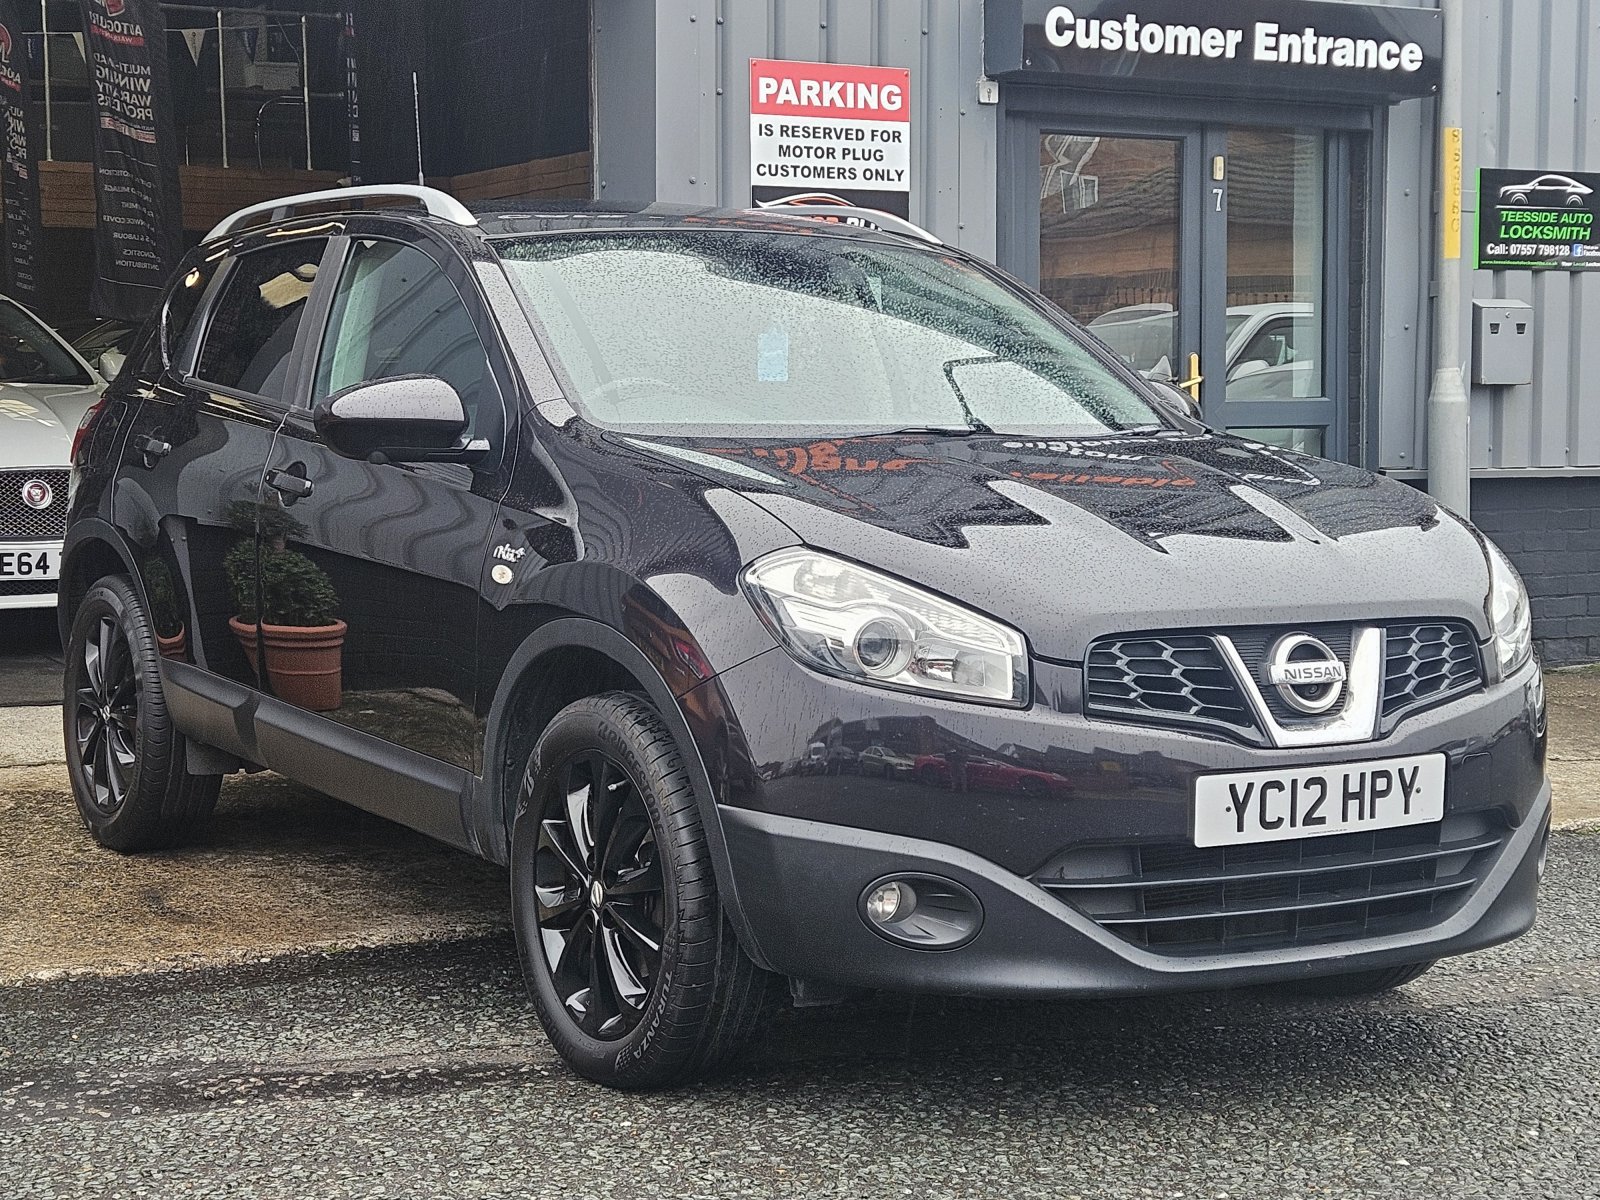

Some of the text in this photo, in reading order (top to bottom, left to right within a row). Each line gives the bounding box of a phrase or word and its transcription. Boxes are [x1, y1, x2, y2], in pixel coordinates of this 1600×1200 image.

[1045, 6, 1423, 72] Customer Entrance
[758, 76, 902, 111] PARKING
[758, 123, 902, 143] IS RESERVED FOR
[778, 145, 884, 162] MOTOR PLUG
[756, 163, 904, 182] CUSTOMERS ONLY
[1212, 189, 1222, 211] 7
[1500, 211, 1594, 225] TEESSIDE AUTO
[1500, 225, 1591, 240] LOCKSMITH
[1487, 243, 1570, 256] Call: 07557 798128
[1284, 666, 1342, 680] NISSAN
[1228, 765, 1420, 833] YC12 HPY
[633, 970, 674, 1060] TURANZA
